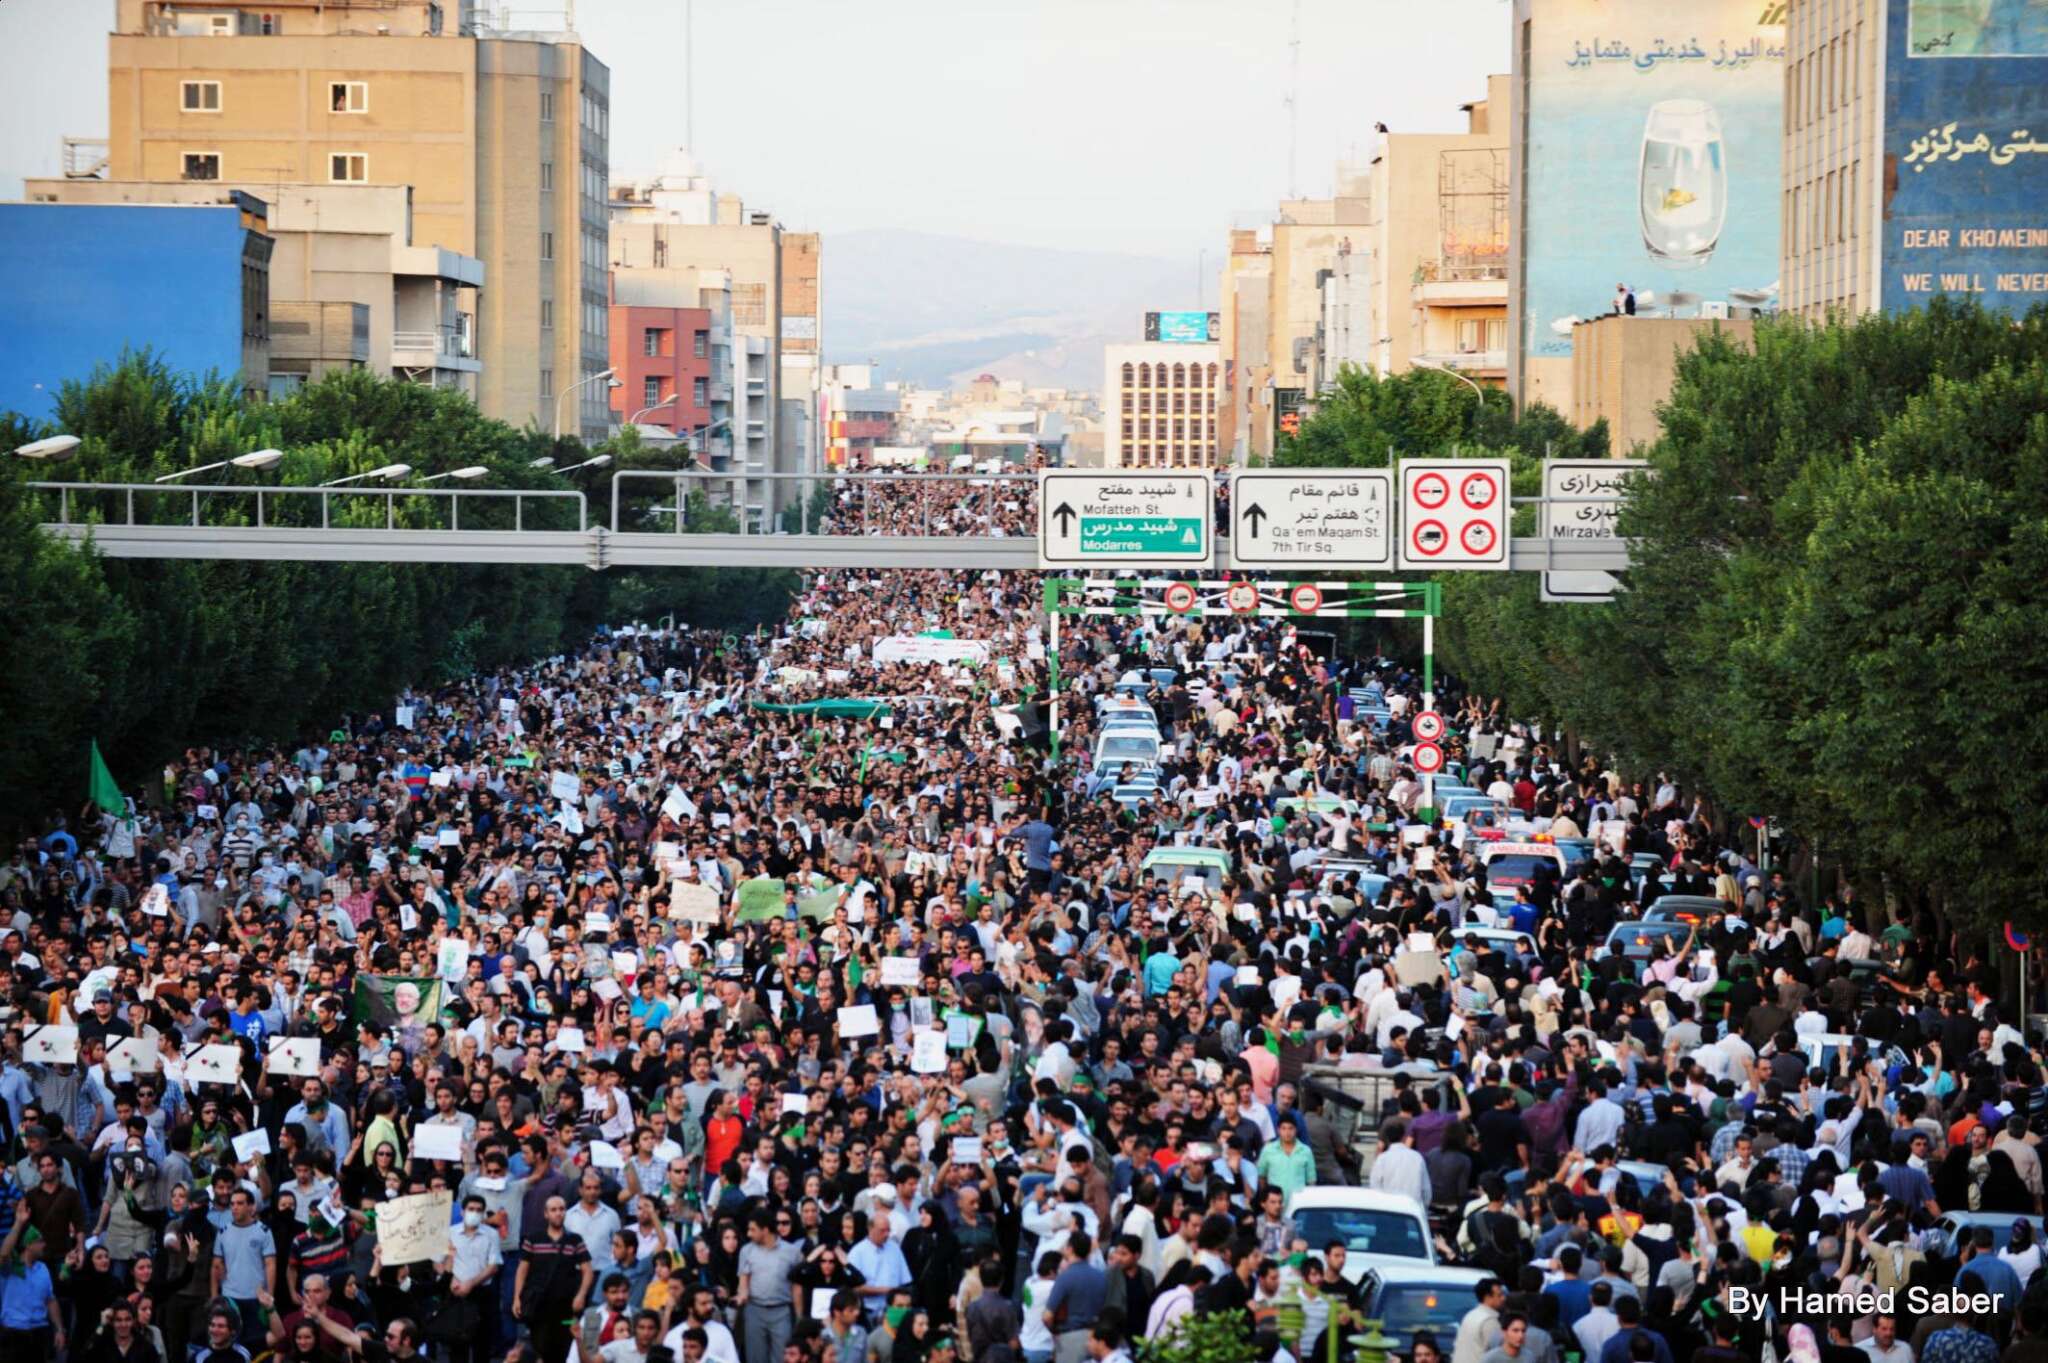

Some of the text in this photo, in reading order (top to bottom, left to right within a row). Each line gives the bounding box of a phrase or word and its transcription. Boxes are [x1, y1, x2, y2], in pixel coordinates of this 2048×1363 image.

[1566, 38, 1631, 66] متمایز
[1634, 37, 1706, 68] خدمتی
[1712, 37, 1760, 66] البرز
[1903, 229, 2048, 248] DEAR KHOMEINI
[1903, 273, 1933, 292] WE
[1939, 273, 1985, 292] WILL
[1098, 482, 1177, 501] شهید مفتح
[1289, 483, 1359, 503] قائم مقام
[1083, 504, 1140, 515] Mofatteh
[1296, 508, 1359, 526] هفتم تیر
[1083, 518, 1178, 536] شهید مدرس
[1082, 540, 1143, 552] Modarres
[1272, 542, 1292, 552] 7th
[1297, 542, 1311, 552] Tir
